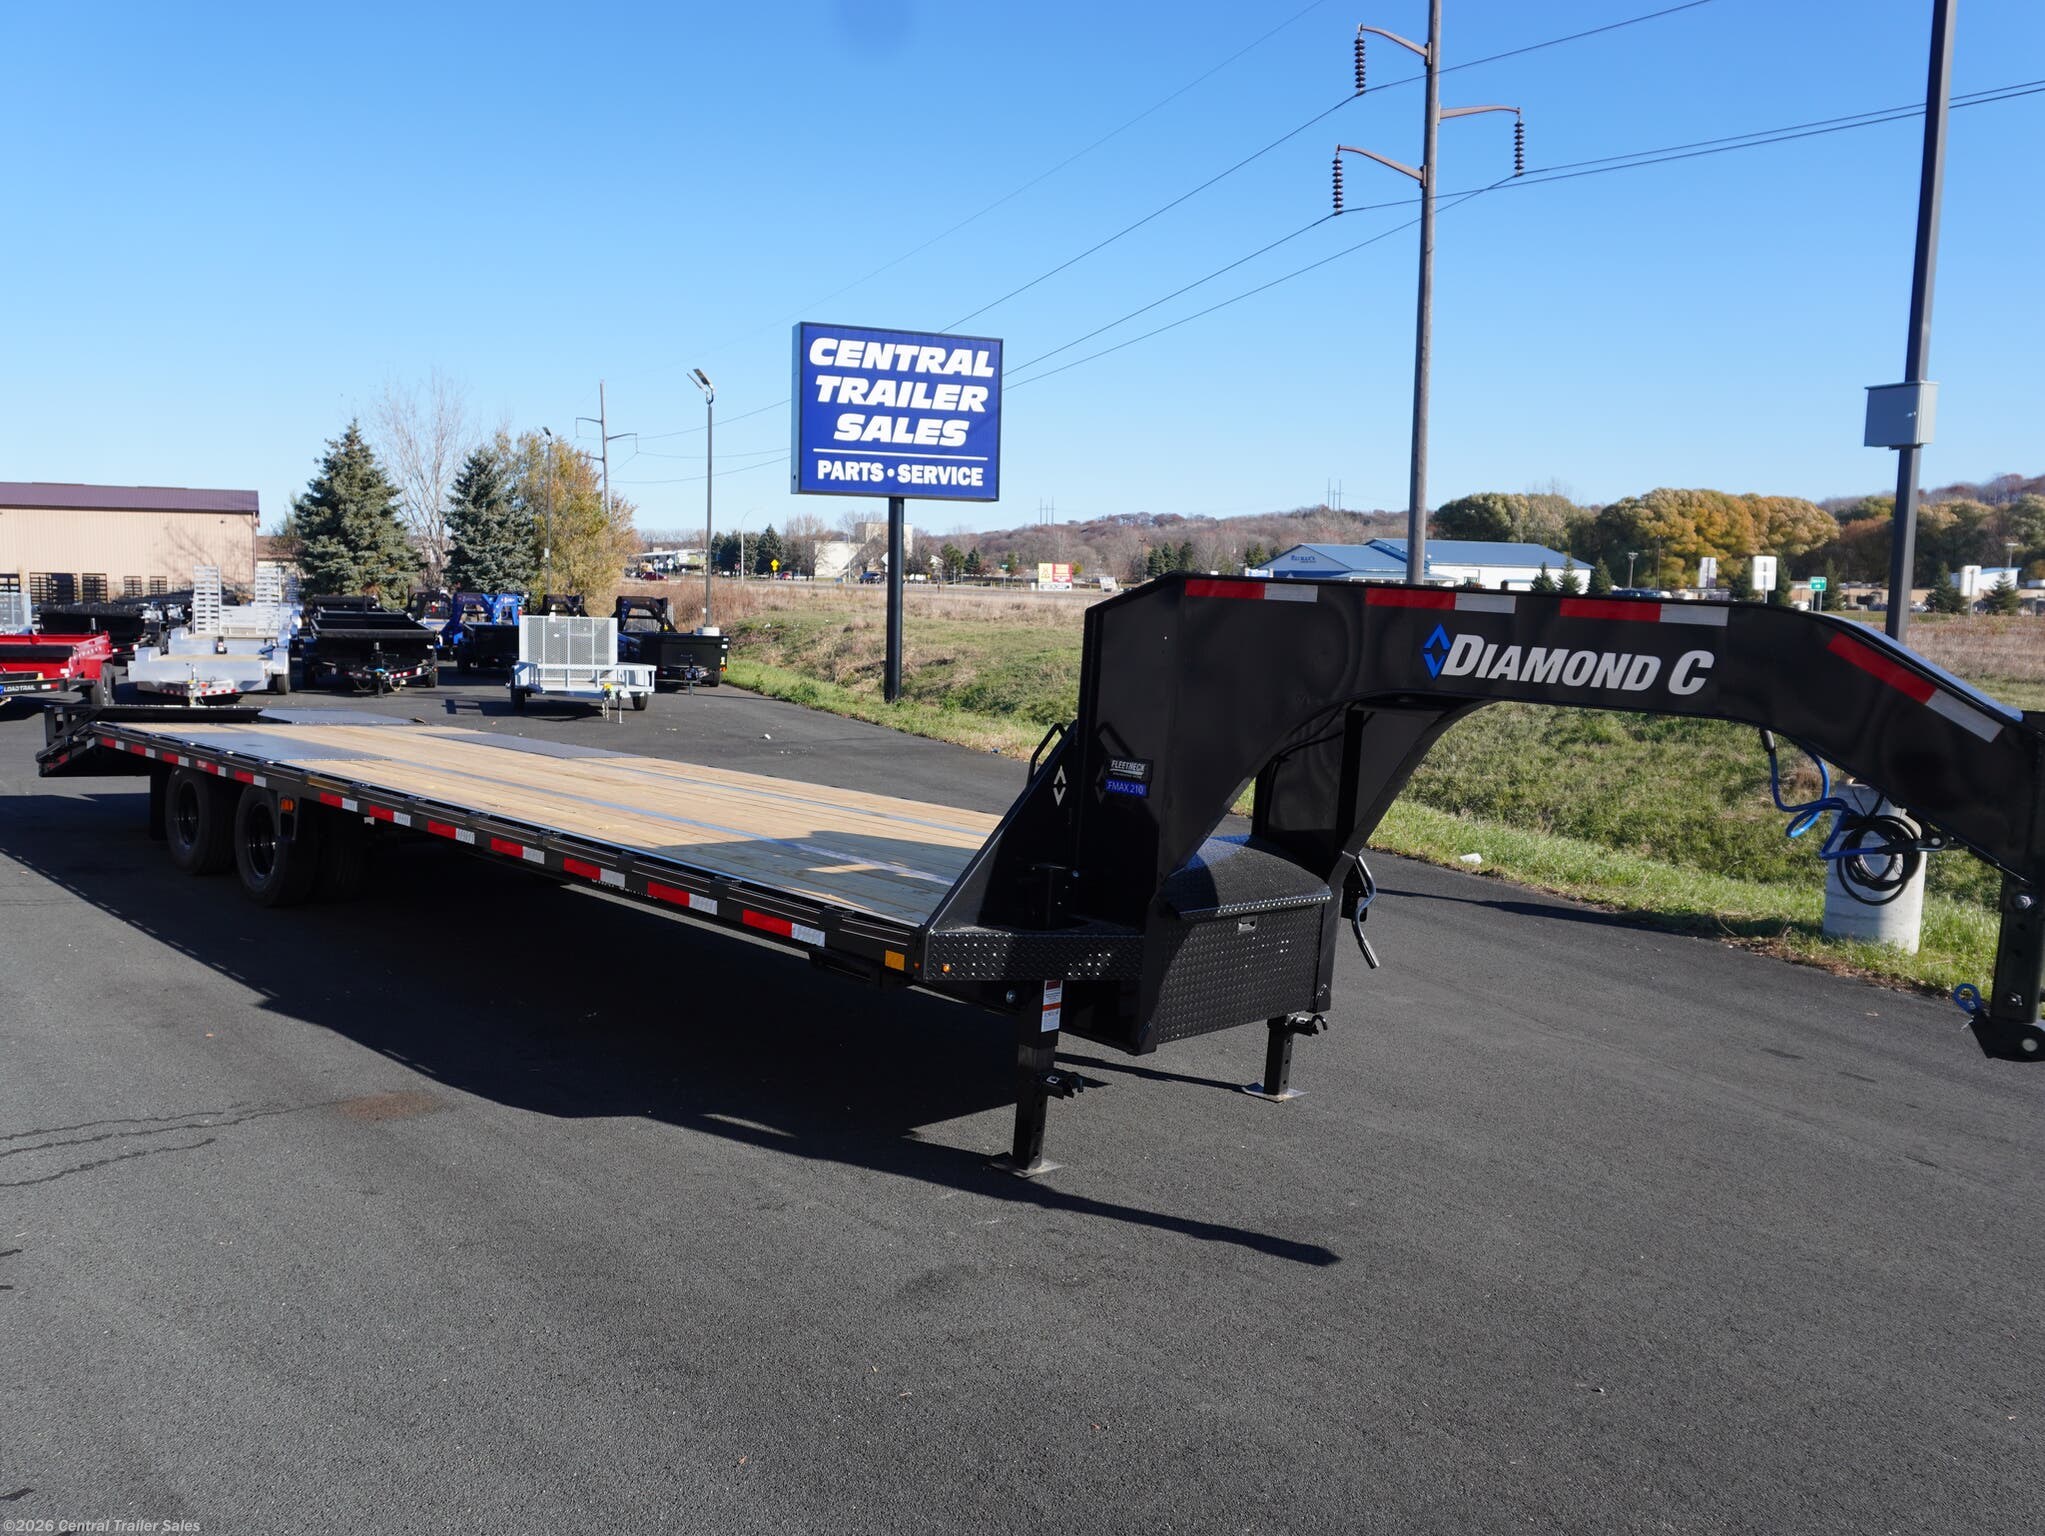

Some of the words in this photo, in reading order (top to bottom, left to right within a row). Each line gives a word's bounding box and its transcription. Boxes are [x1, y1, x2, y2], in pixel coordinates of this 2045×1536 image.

[809, 337, 995, 378] CENTRAL
[815, 375, 989, 413] TRAILER
[833, 413, 970, 447] SALES
[817, 460, 884, 482] PARTS
[897, 464, 984, 487] SERVICE
[1441, 633, 1662, 692] DIAMOND
[1668, 650, 1715, 695] C
[1130, 784, 1144, 795] 210
